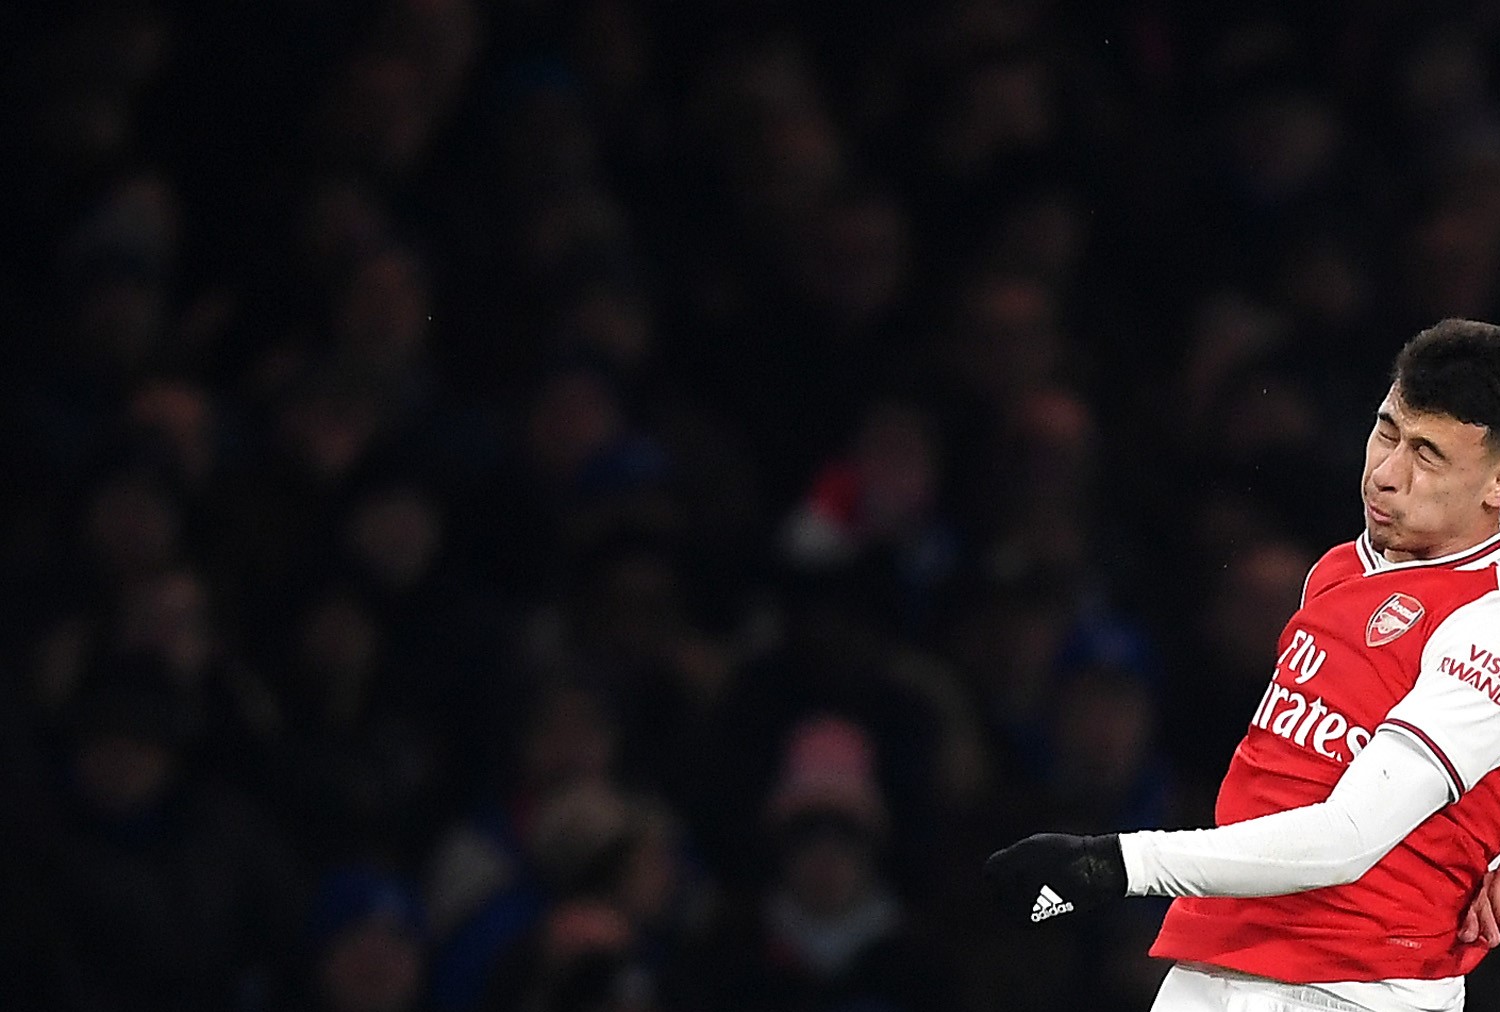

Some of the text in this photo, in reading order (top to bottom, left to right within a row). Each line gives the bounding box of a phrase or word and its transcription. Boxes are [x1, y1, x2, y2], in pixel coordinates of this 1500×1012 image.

[1278, 629, 1327, 684] Fly
[1252, 668, 1372, 764] irates
[1030, 901, 1074, 922] adidas
